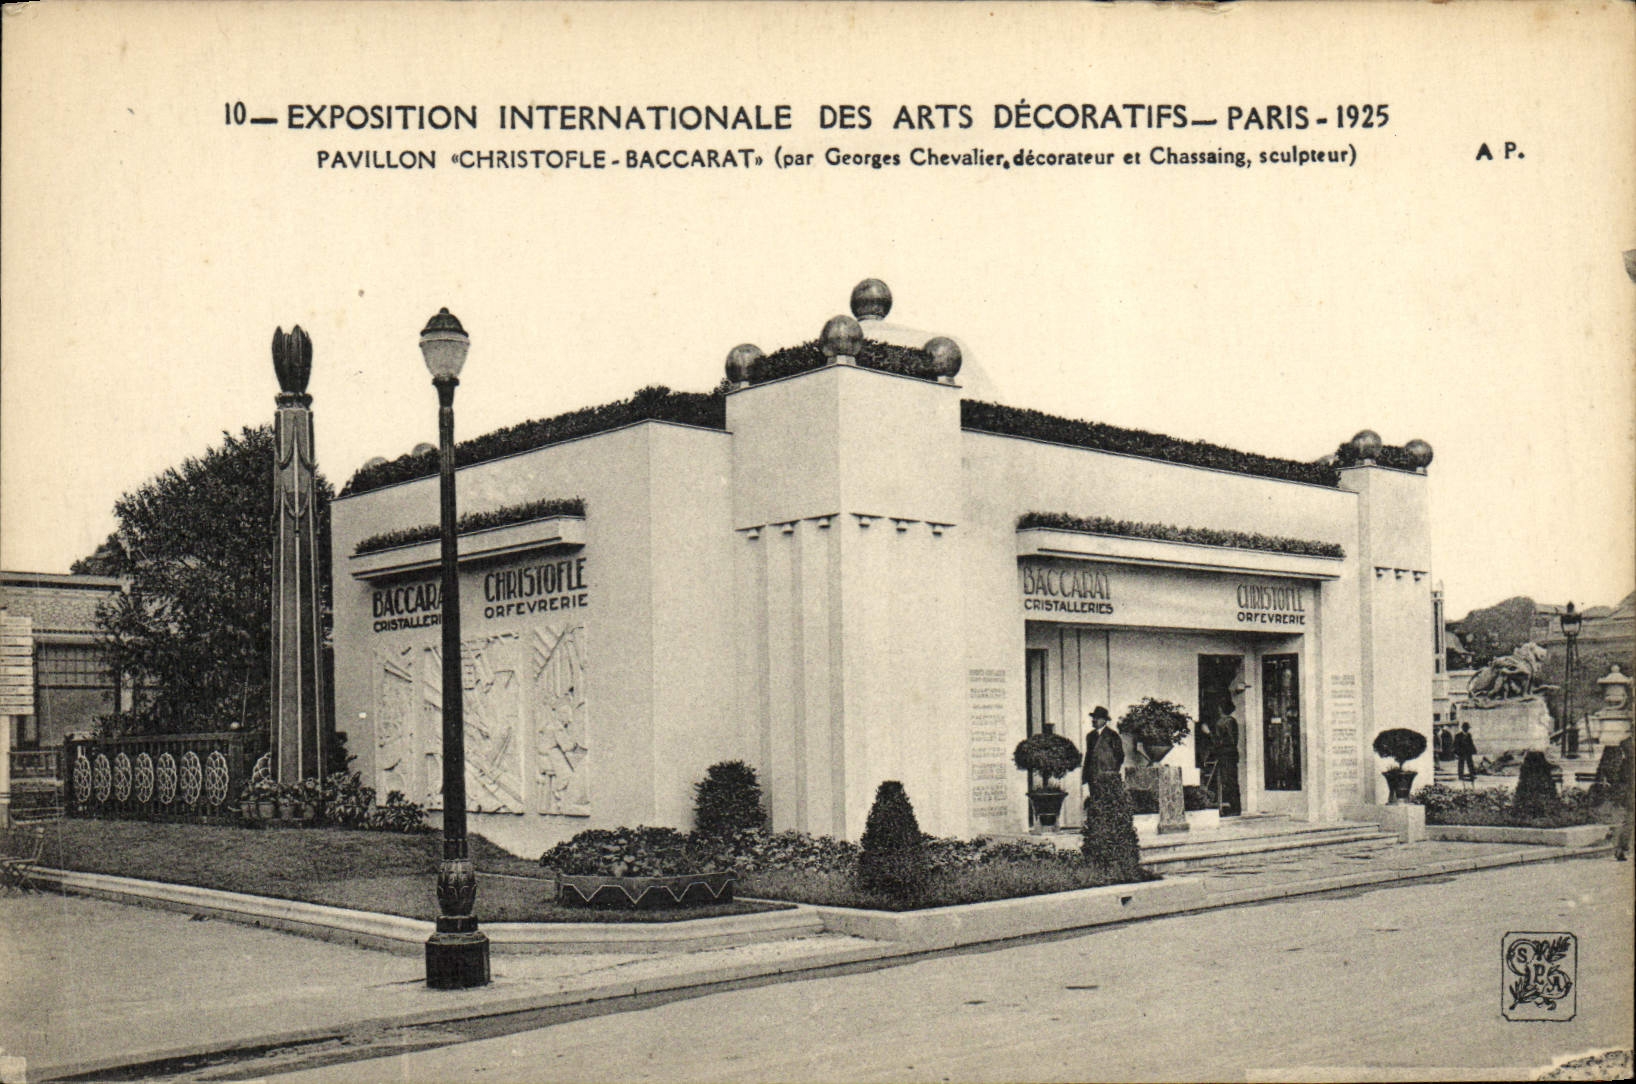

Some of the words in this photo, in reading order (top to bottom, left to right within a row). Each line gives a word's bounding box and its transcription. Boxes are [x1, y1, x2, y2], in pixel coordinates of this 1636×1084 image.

[484, 557, 588, 602] CHRISTOFLE
[1023, 566, 1110, 600] BACCARAT
[373, 582, 443, 618] BACCARA
[484, 593, 588, 619] ORFEVRERIE
[1024, 598, 1115, 615] CRISTALLERIES
[373, 613, 443, 633] CRISTALLERI
[1237, 611, 1306, 626] ORFEVRERIE
